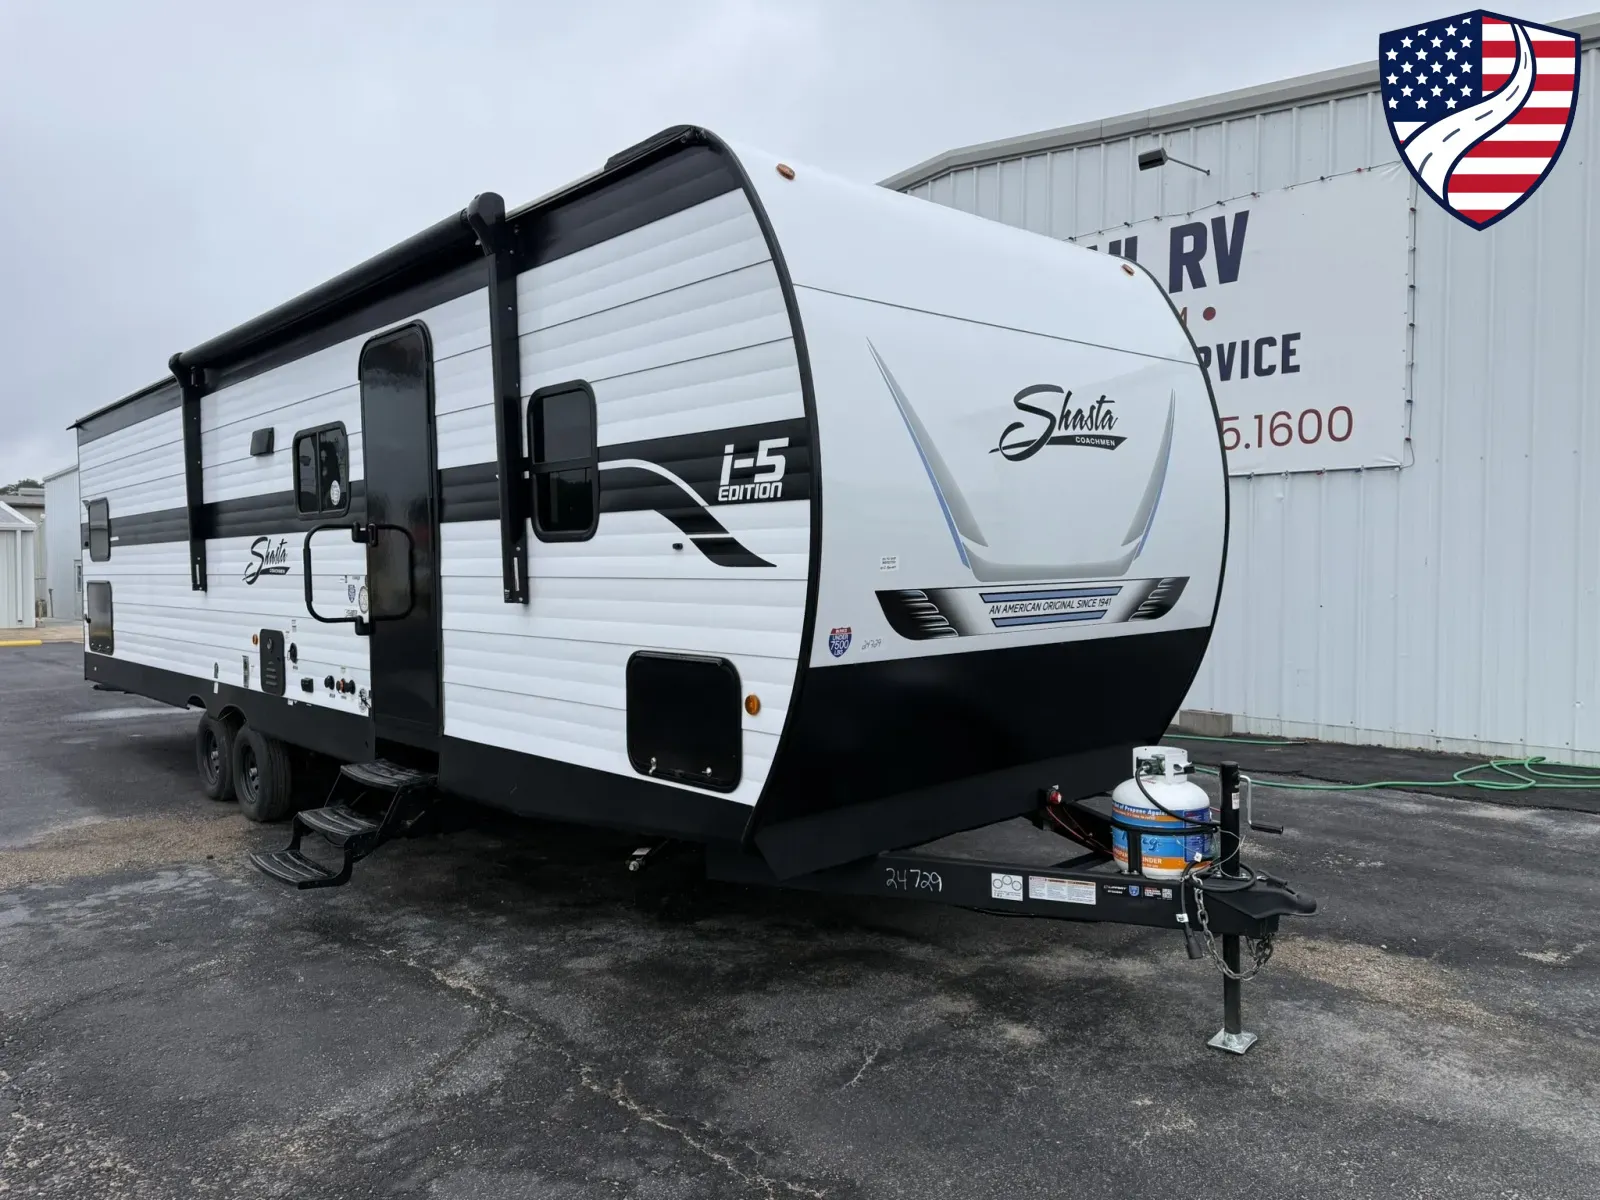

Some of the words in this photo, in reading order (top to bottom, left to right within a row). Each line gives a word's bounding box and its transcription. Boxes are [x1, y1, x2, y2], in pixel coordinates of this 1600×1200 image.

[1169, 209, 1250, 295] RV
[999, 384, 1119, 462] Shasta
[1220, 405, 1354, 451] 5.1600
[1075, 436, 1116, 447] COACHMEN
[718, 481, 783, 502] EDITION
[244, 536, 289, 585] Shasta
[989, 604, 1001, 615] AN
[1002, 601, 1041, 614] AMERICAN
[1042, 600, 1075, 611] ORIGINAL
[1076, 598, 1098, 608] SINCE
[1098, 597, 1112, 607] 1941
[830, 639, 849, 650] 7500
[886, 867, 942, 892] 24729
